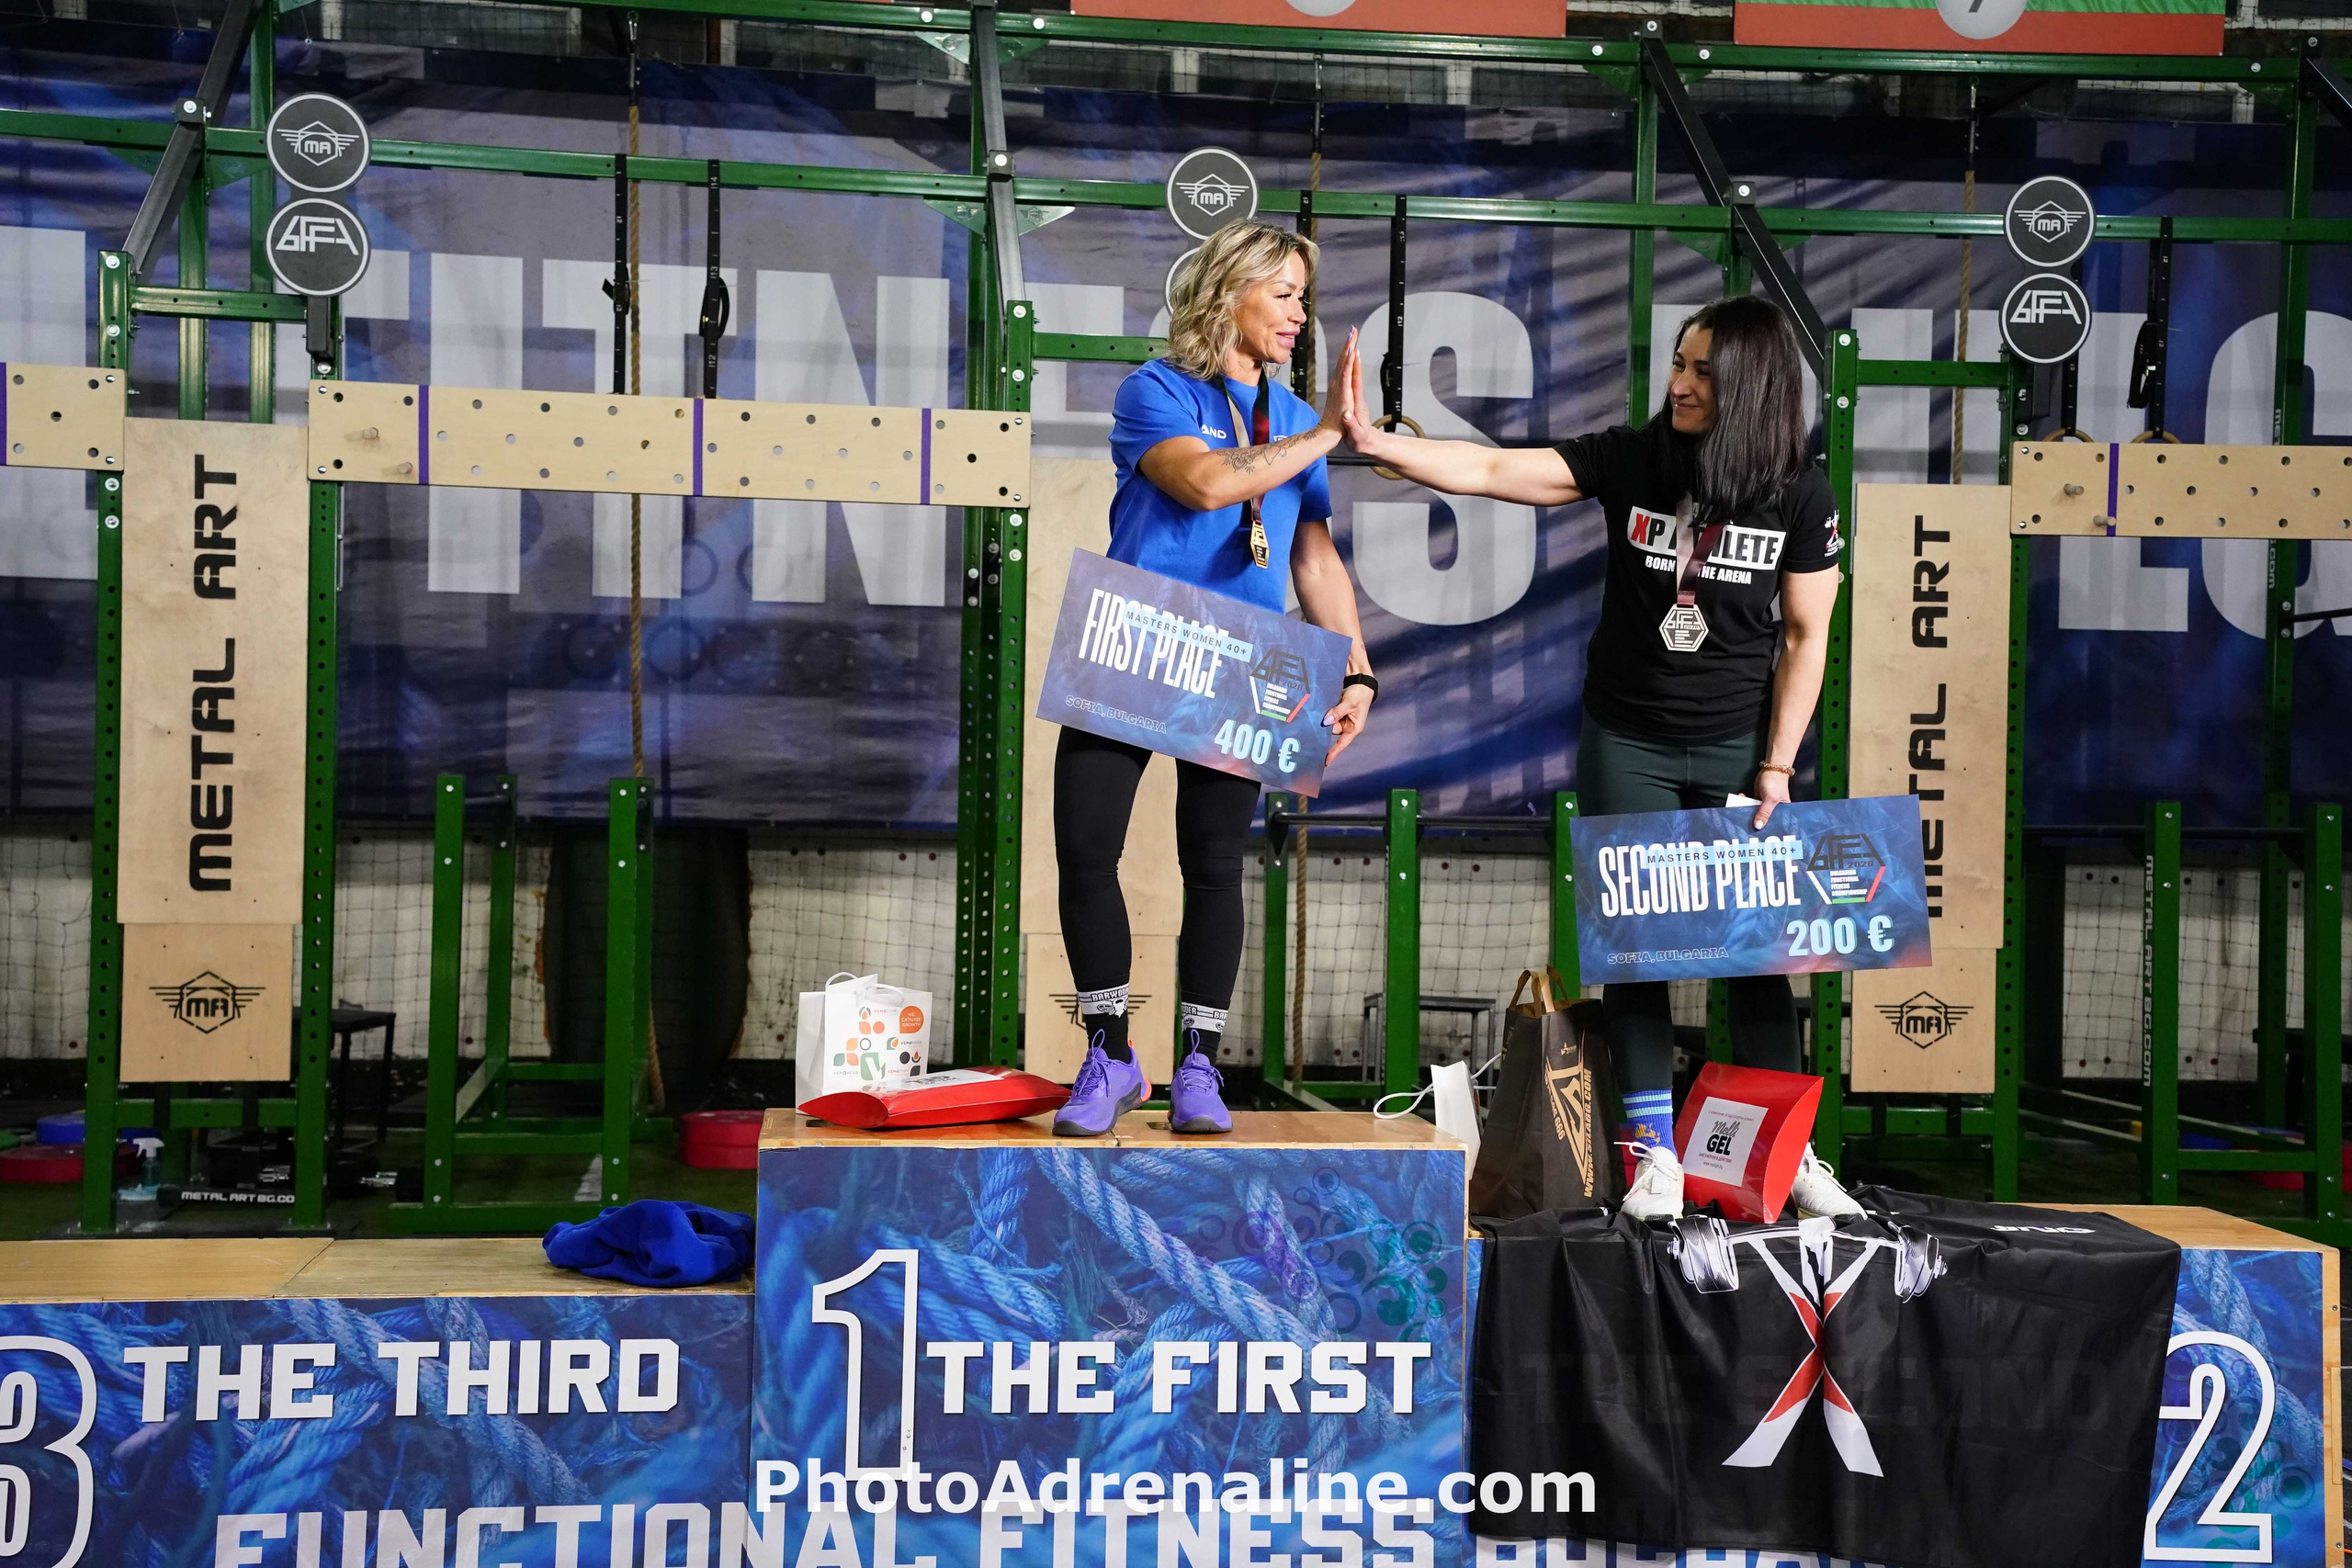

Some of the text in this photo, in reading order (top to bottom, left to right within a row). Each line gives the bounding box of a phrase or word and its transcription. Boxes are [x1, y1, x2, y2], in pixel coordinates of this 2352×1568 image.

[1631, 513, 1666, 547] XP
[1645, 555, 1677, 572] BORN
[1717, 570, 1752, 584] ARENA
[1912, 514, 1951, 649] ART
[1079, 588, 1229, 699] FIRST PLACE
[1125, 611, 1248, 656] MASTERS WOMEN 40+
[189, 454, 236, 891] METAL ART
[1066, 695, 1167, 734] SOFIA, BULGARIA
[1214, 719, 1301, 773] 400 €
[1598, 835, 1802, 918] SECOND PLACE
[1646, 845, 1797, 864] MASTERS WOMEN 40+
[2144, 855, 2154, 940] METAL
[1607, 947, 1729, 964] SOFIA, BULGARIA
[1787, 915, 1895, 957] 200 €
[2143, 946, 2153, 994] ART
[1706, 1134, 1732, 1156] GEL
[181, 1191, 227, 1201] METAL
[230, 1193, 256, 1201] ART
[123, 1337, 681, 1422] THE THIRD
[812, 1248, 920, 1482] 1
[926, 1341, 1432, 1415] THE FIRST
[2144, 1330, 2275, 1562] 2
